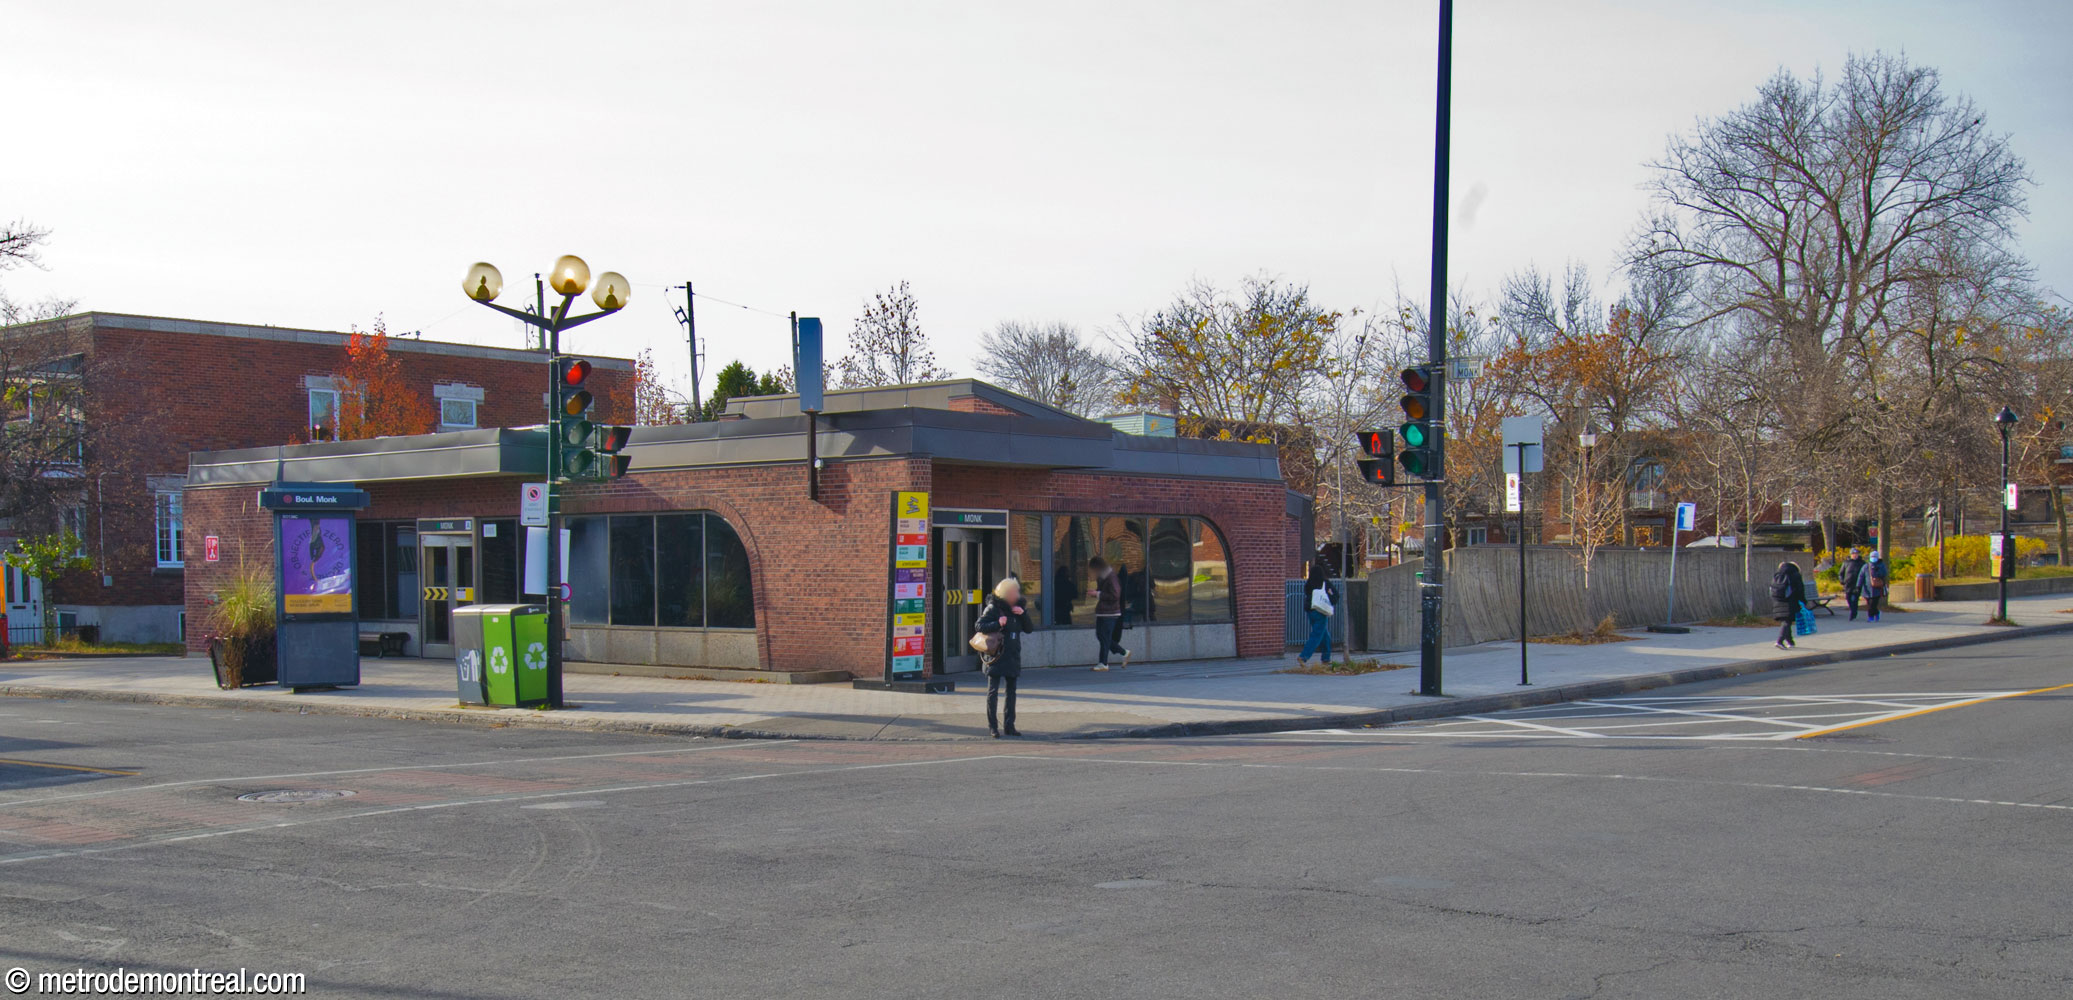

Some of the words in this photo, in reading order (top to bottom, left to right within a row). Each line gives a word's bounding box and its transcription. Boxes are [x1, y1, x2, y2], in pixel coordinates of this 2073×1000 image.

[1458, 367, 1478, 377] MONK
[295, 495, 314, 503] Boul.
[316, 495, 338, 503] Monk
[964, 513, 982, 523] MONK
[440, 521, 454, 530] MONK
[291, 529, 311, 570] OBJECTIF
